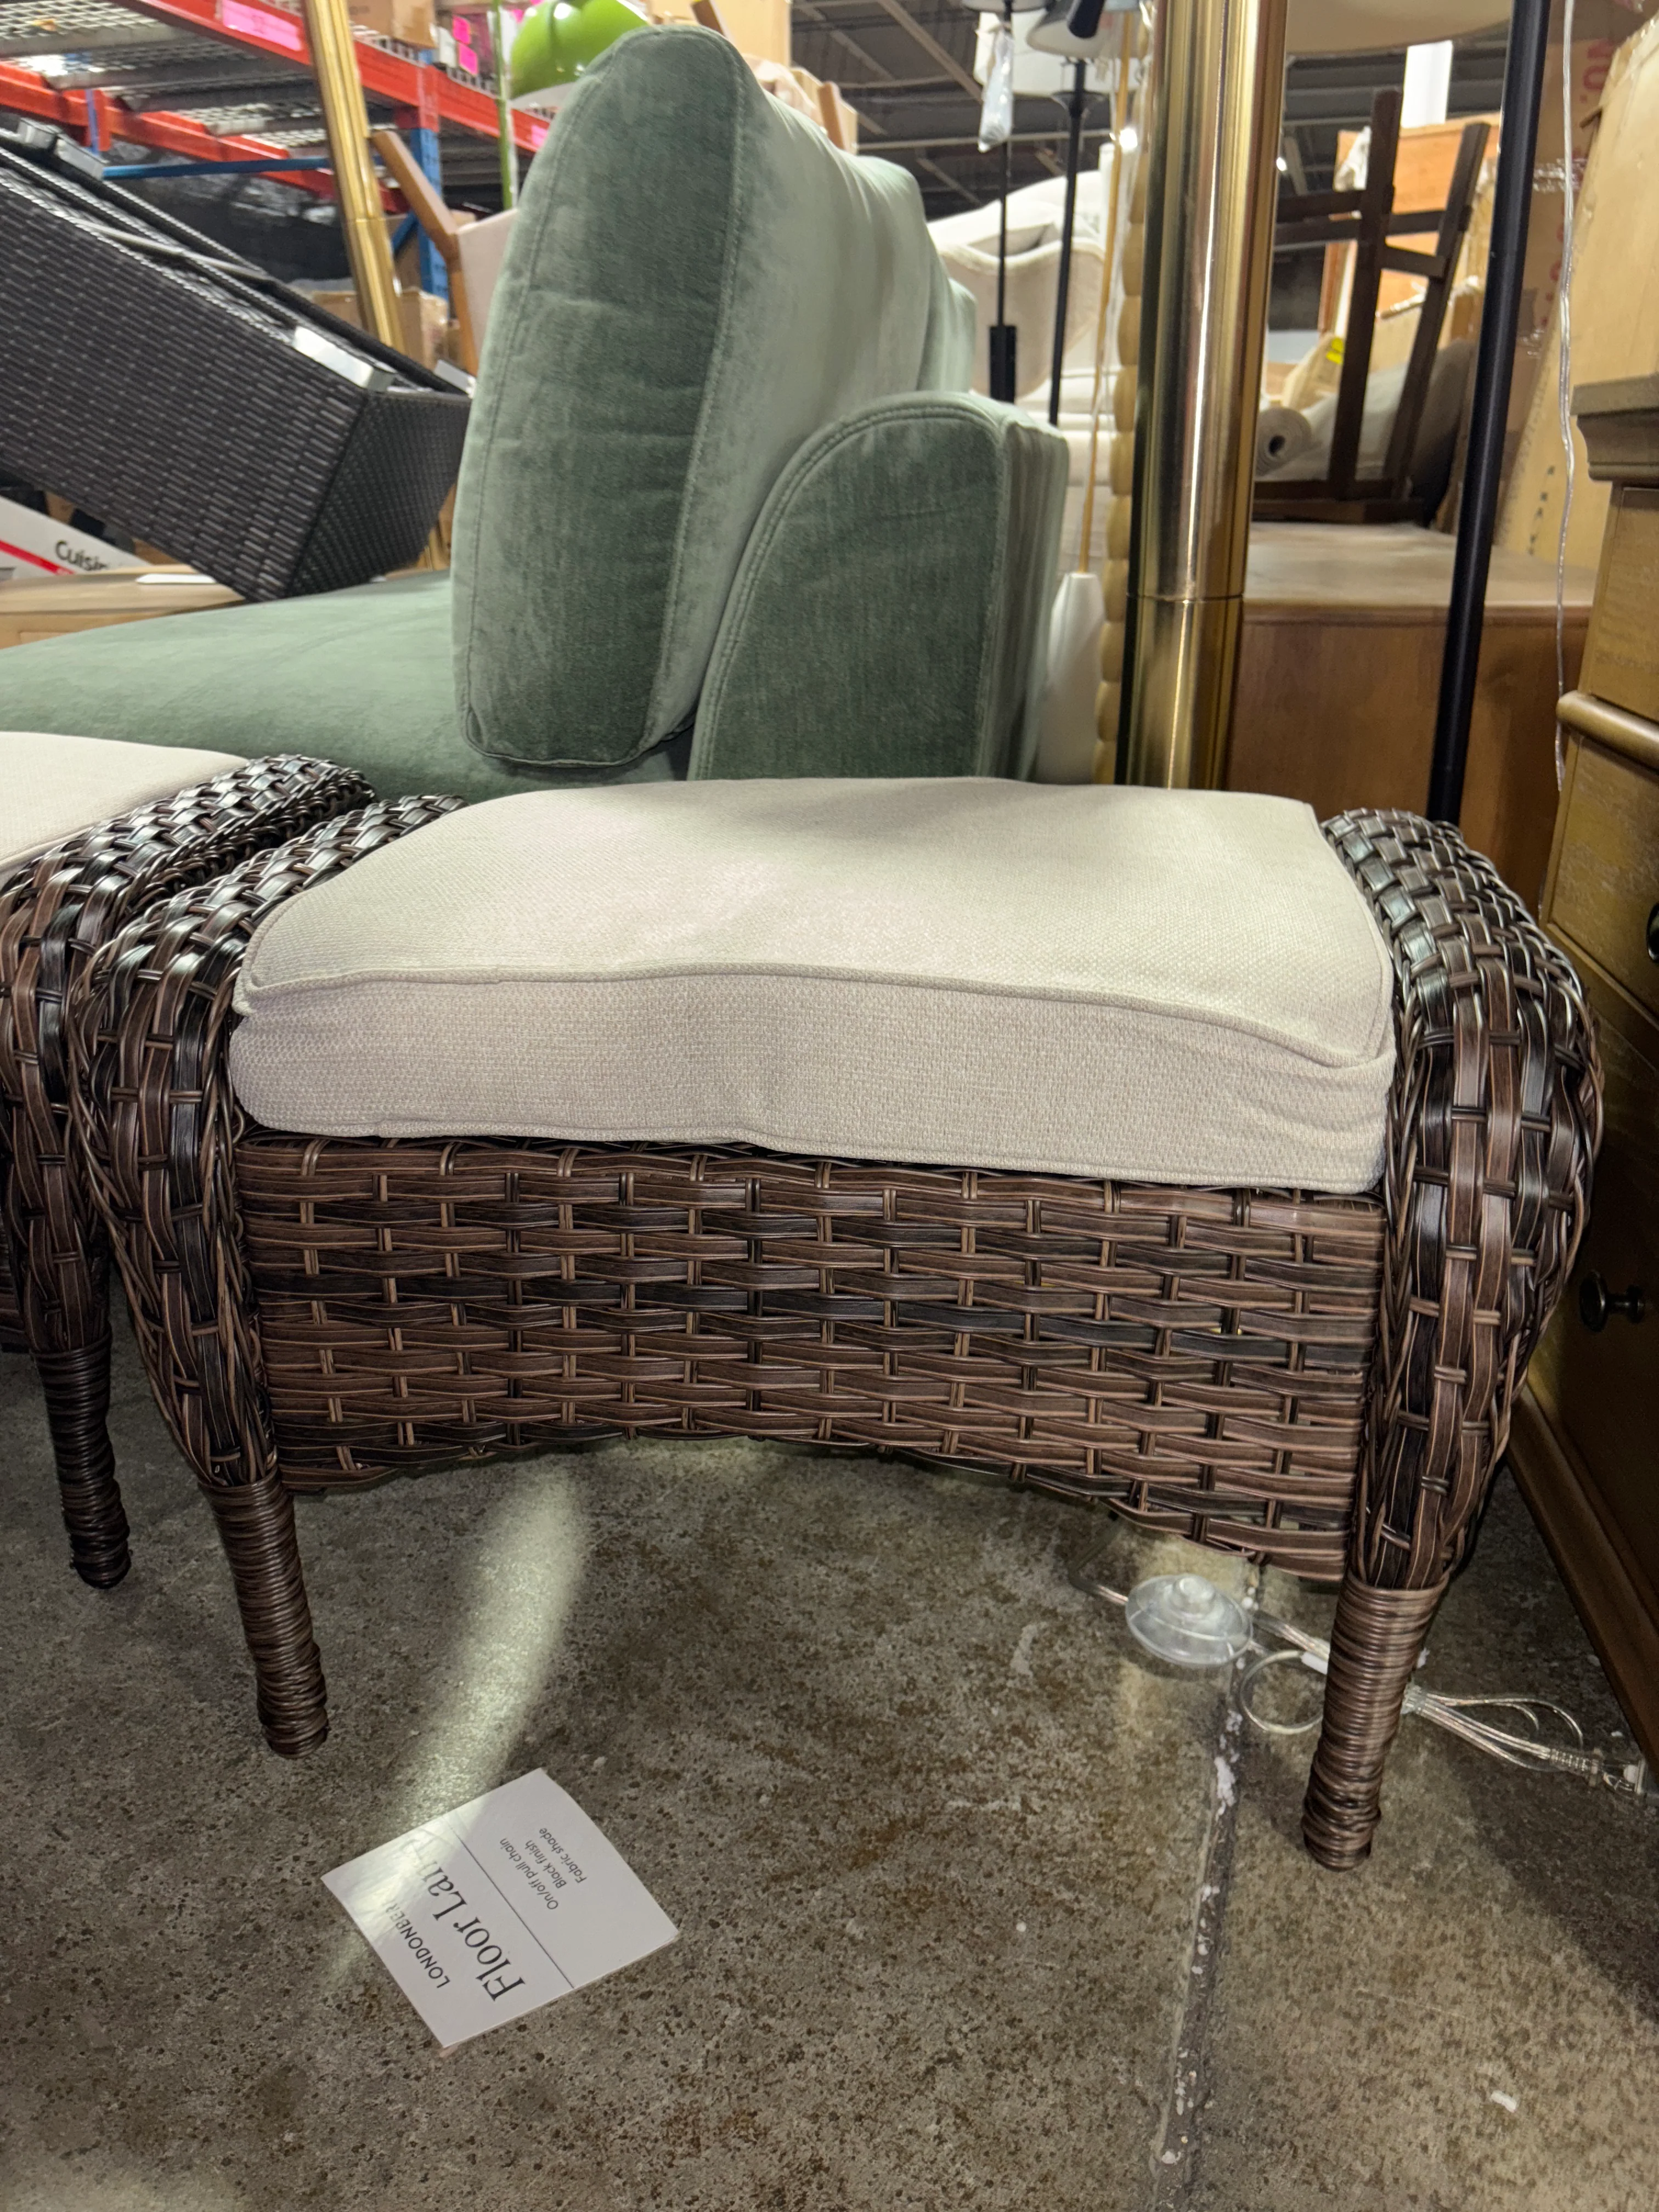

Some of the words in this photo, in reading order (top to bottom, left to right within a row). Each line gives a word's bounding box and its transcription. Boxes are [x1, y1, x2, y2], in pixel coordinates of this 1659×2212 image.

[500, 1838, 522, 1862] chain
[524, 1839, 548, 1864] finish
[539, 1827, 564, 1854] shade
[515, 1861, 539, 1879] pull
[543, 1863, 567, 1889] Black
[560, 1853, 588, 1883] Fabric
[528, 1878, 558, 1910] On/off
[453, 1916, 526, 2002] Floor
